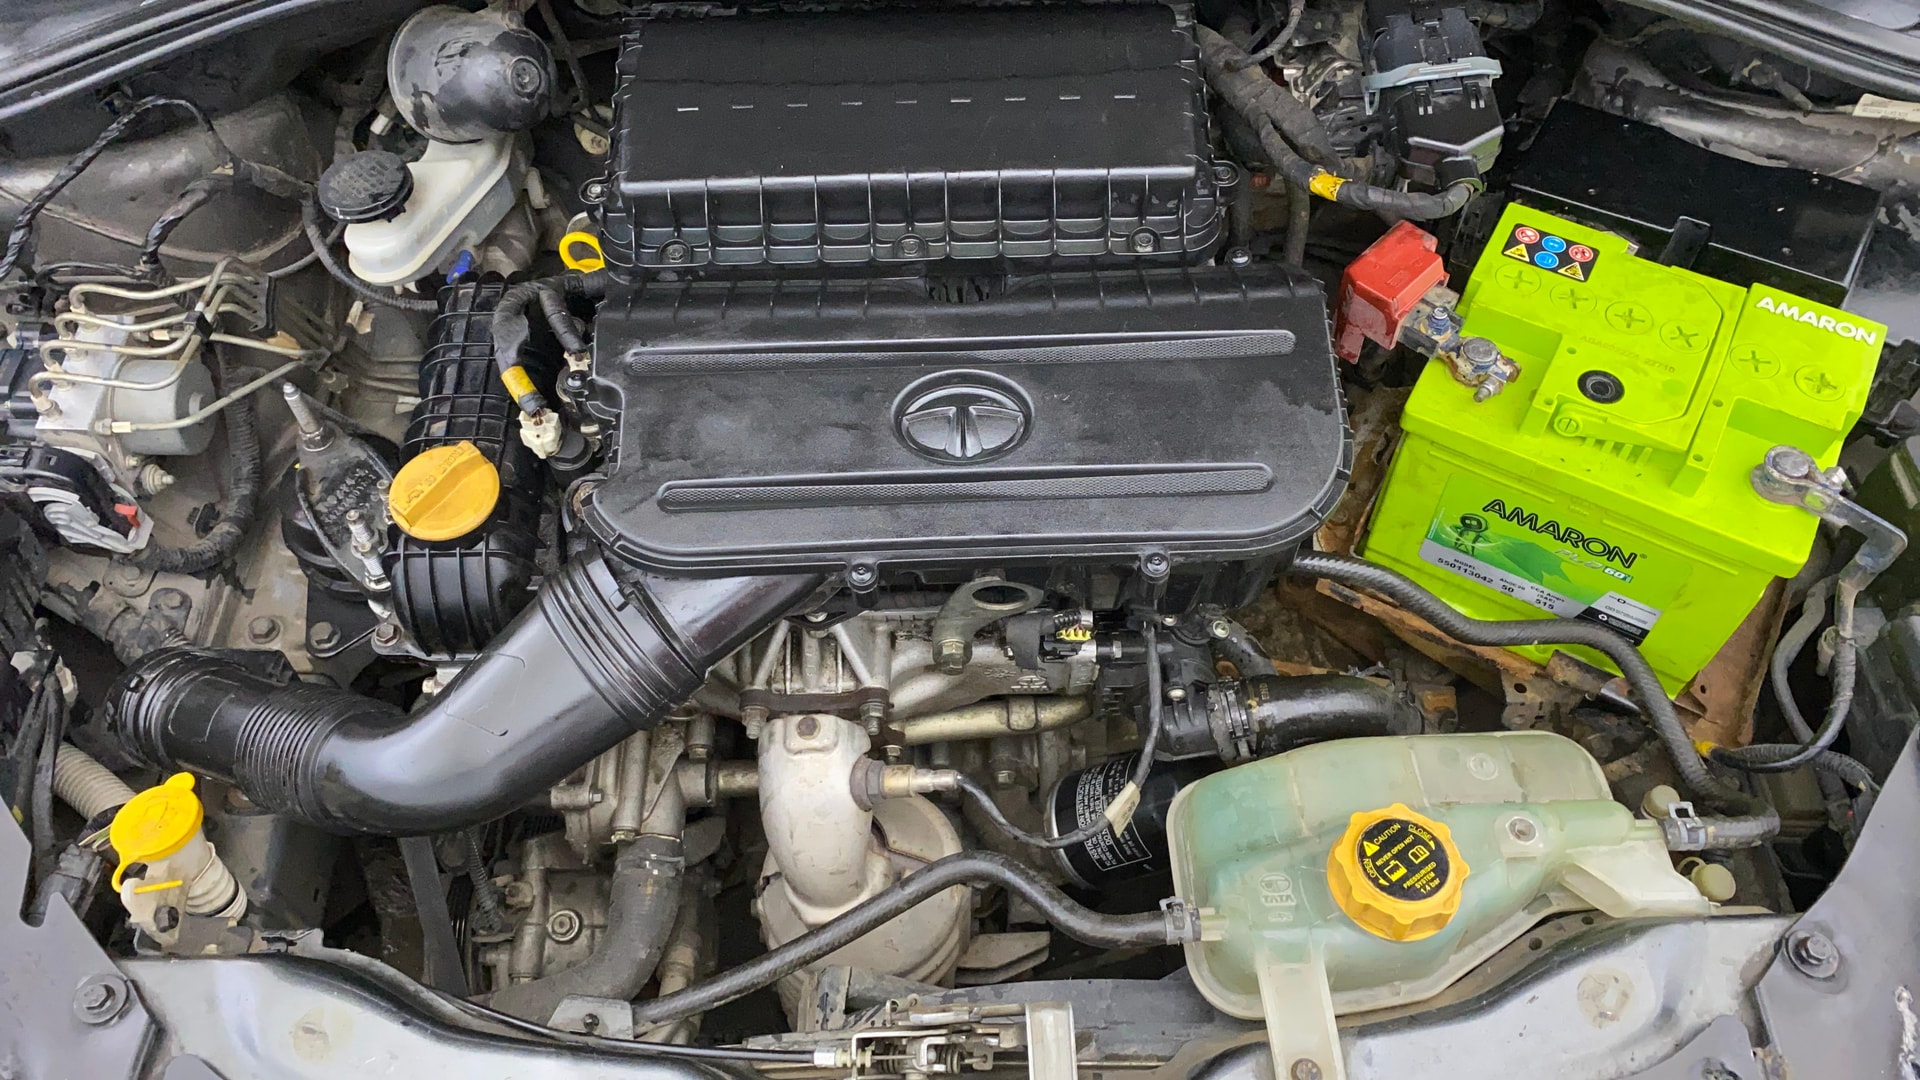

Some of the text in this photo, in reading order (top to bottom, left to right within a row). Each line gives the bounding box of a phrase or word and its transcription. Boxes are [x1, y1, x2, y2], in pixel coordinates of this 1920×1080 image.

[1756, 297, 1876, 345] AMARON
[1482, 499, 1637, 568] AMARON
[1437, 558, 1493, 584] 550113042
[1453, 558, 1476, 570] MODEL
[1501, 584, 1514, 593] 50
[1535, 599, 1554, 610] 515
[1374, 823, 1401, 844] CAUTION
[1408, 824, 1432, 839] CLOSE
[1375, 834, 1414, 866] NEVER OPEN HOT
[1363, 859, 1376, 878] OPEN
[1403, 861, 1437, 888] PRESSURISED
[1415, 871, 1435, 889] SYSTEM
[1431, 878, 1440, 888] bar
[1262, 894, 1294, 904] TATA
